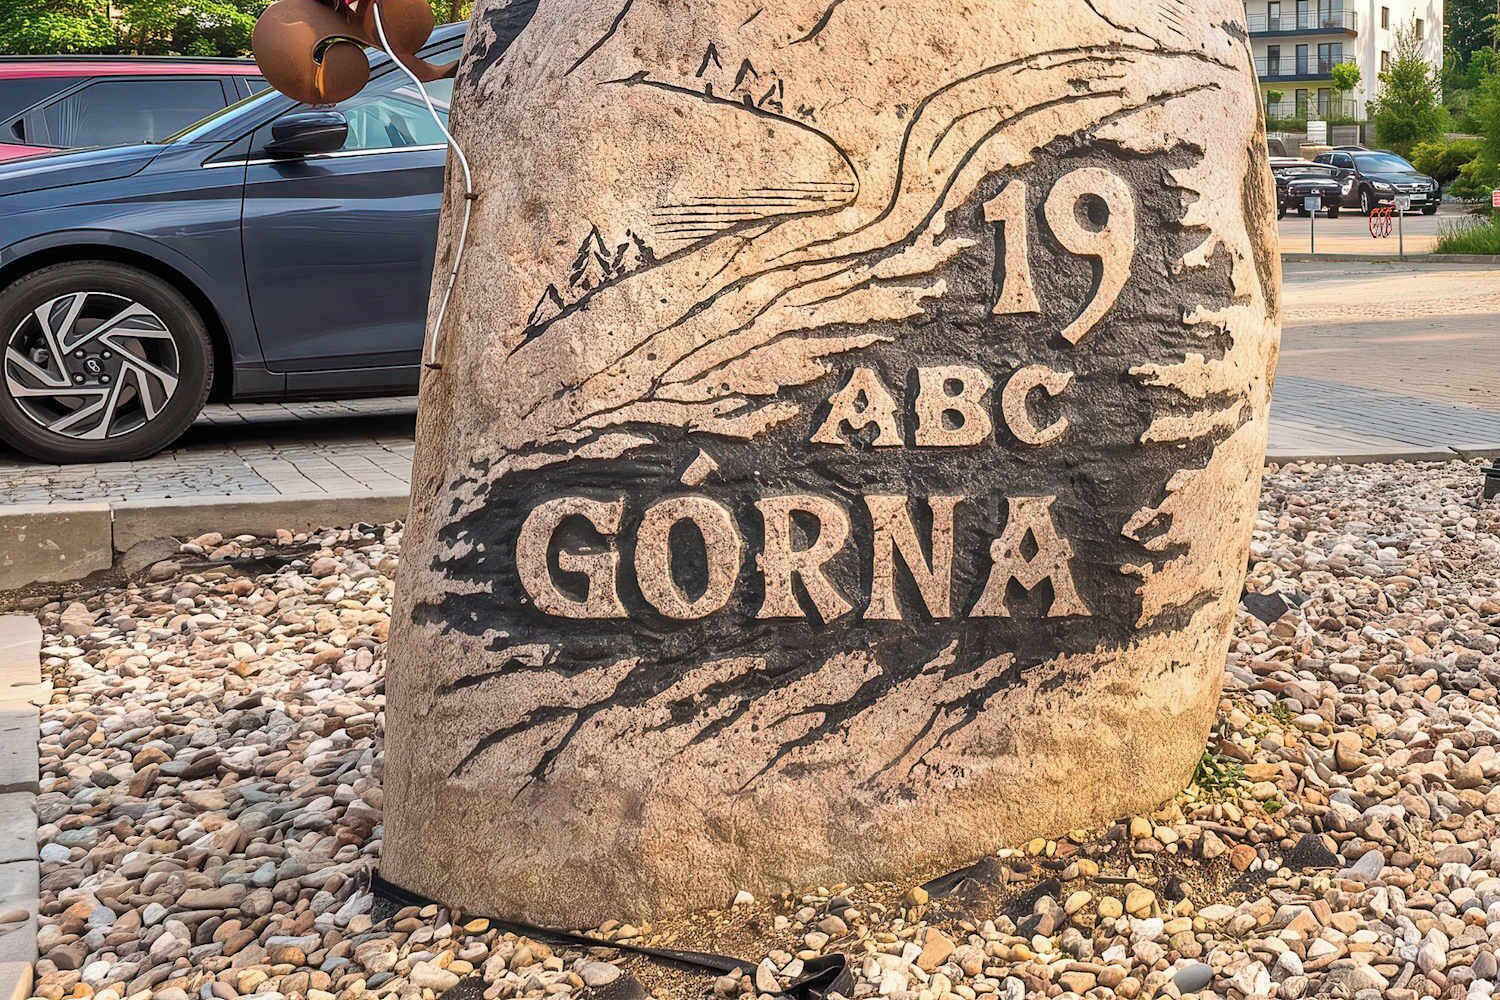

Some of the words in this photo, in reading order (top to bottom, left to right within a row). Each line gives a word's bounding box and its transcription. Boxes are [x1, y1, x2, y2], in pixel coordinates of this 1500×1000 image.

[984, 166, 1137, 345] 19
[809, 363, 1075, 448] ABC
[515, 449, 1093, 624] GÓRNA
